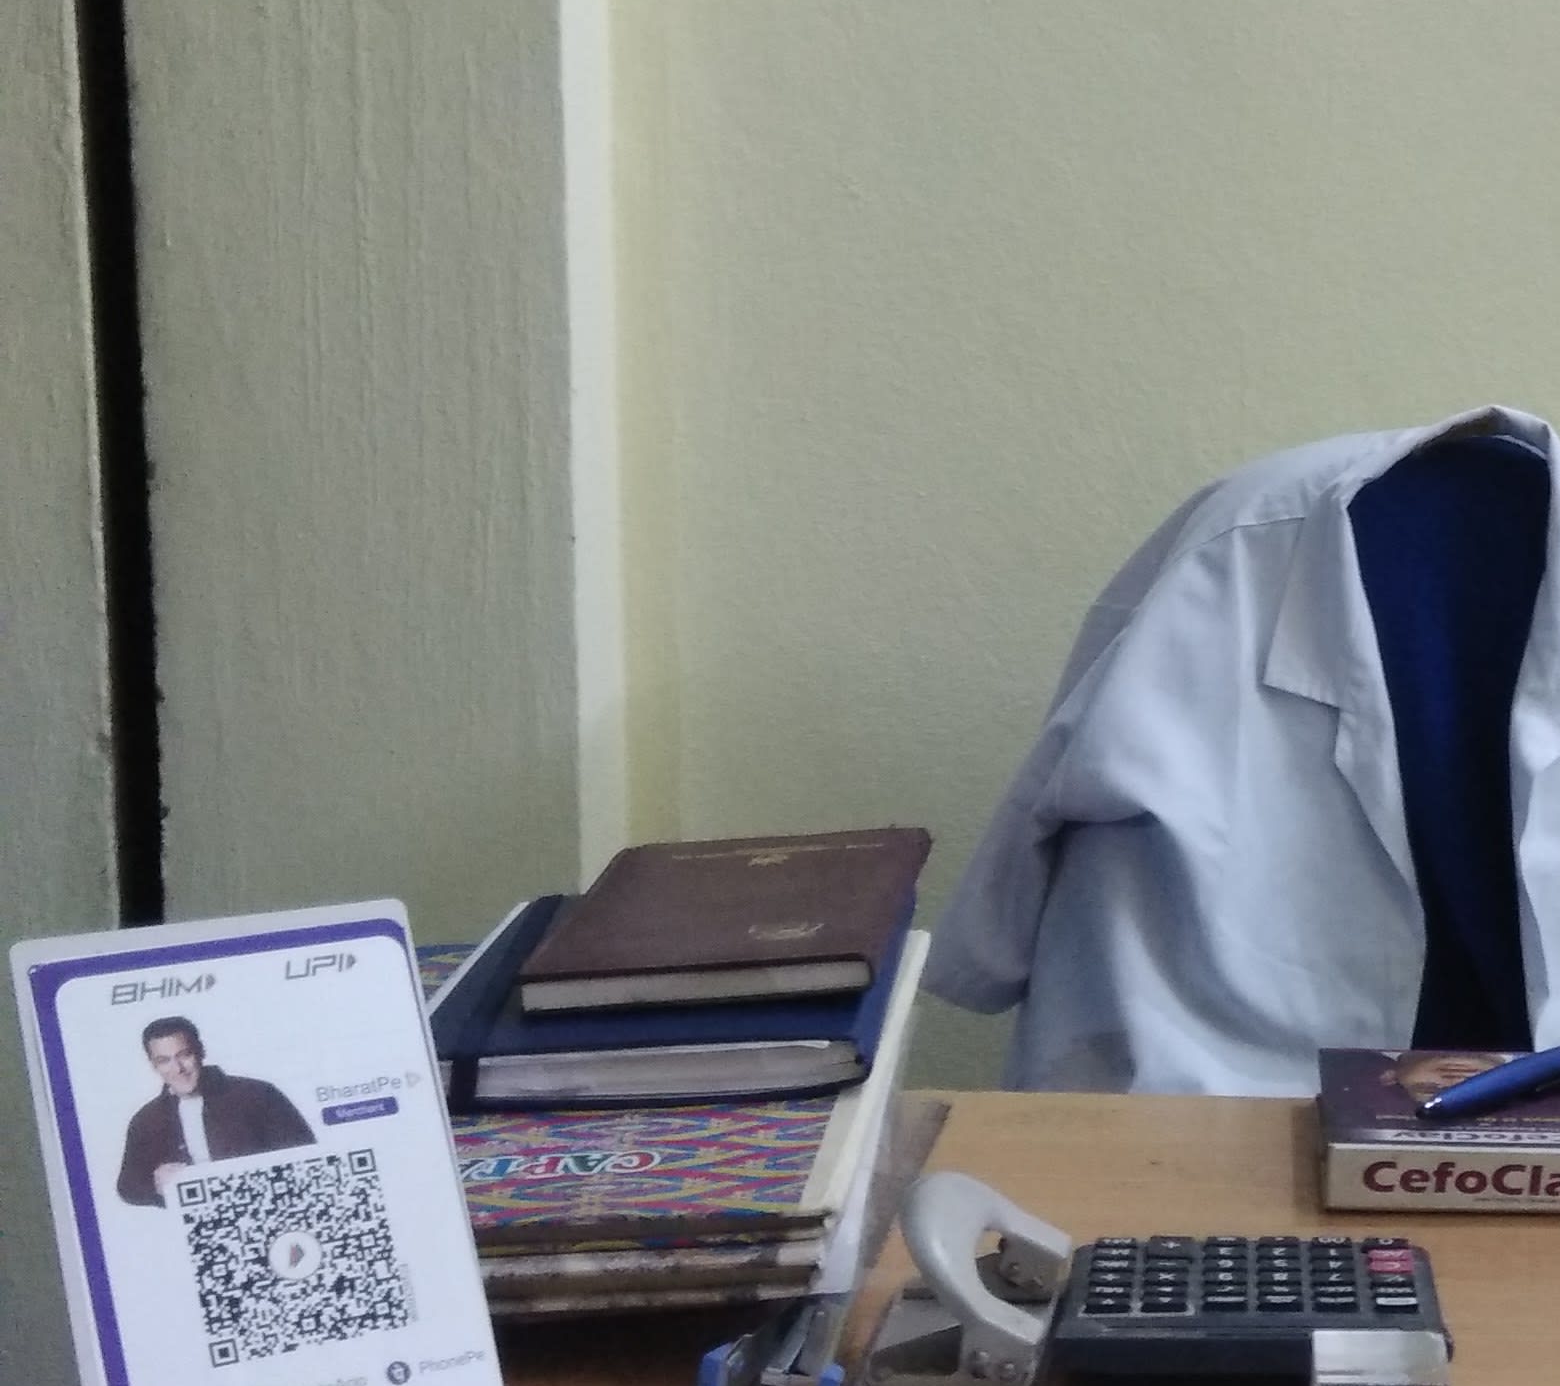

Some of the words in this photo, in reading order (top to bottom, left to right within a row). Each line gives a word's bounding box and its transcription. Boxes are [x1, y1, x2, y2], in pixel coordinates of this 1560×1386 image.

[112, 974, 204, 1005] BHIM
[285, 953, 345, 980] UPI
[315, 1075, 402, 1102] BharatPe
